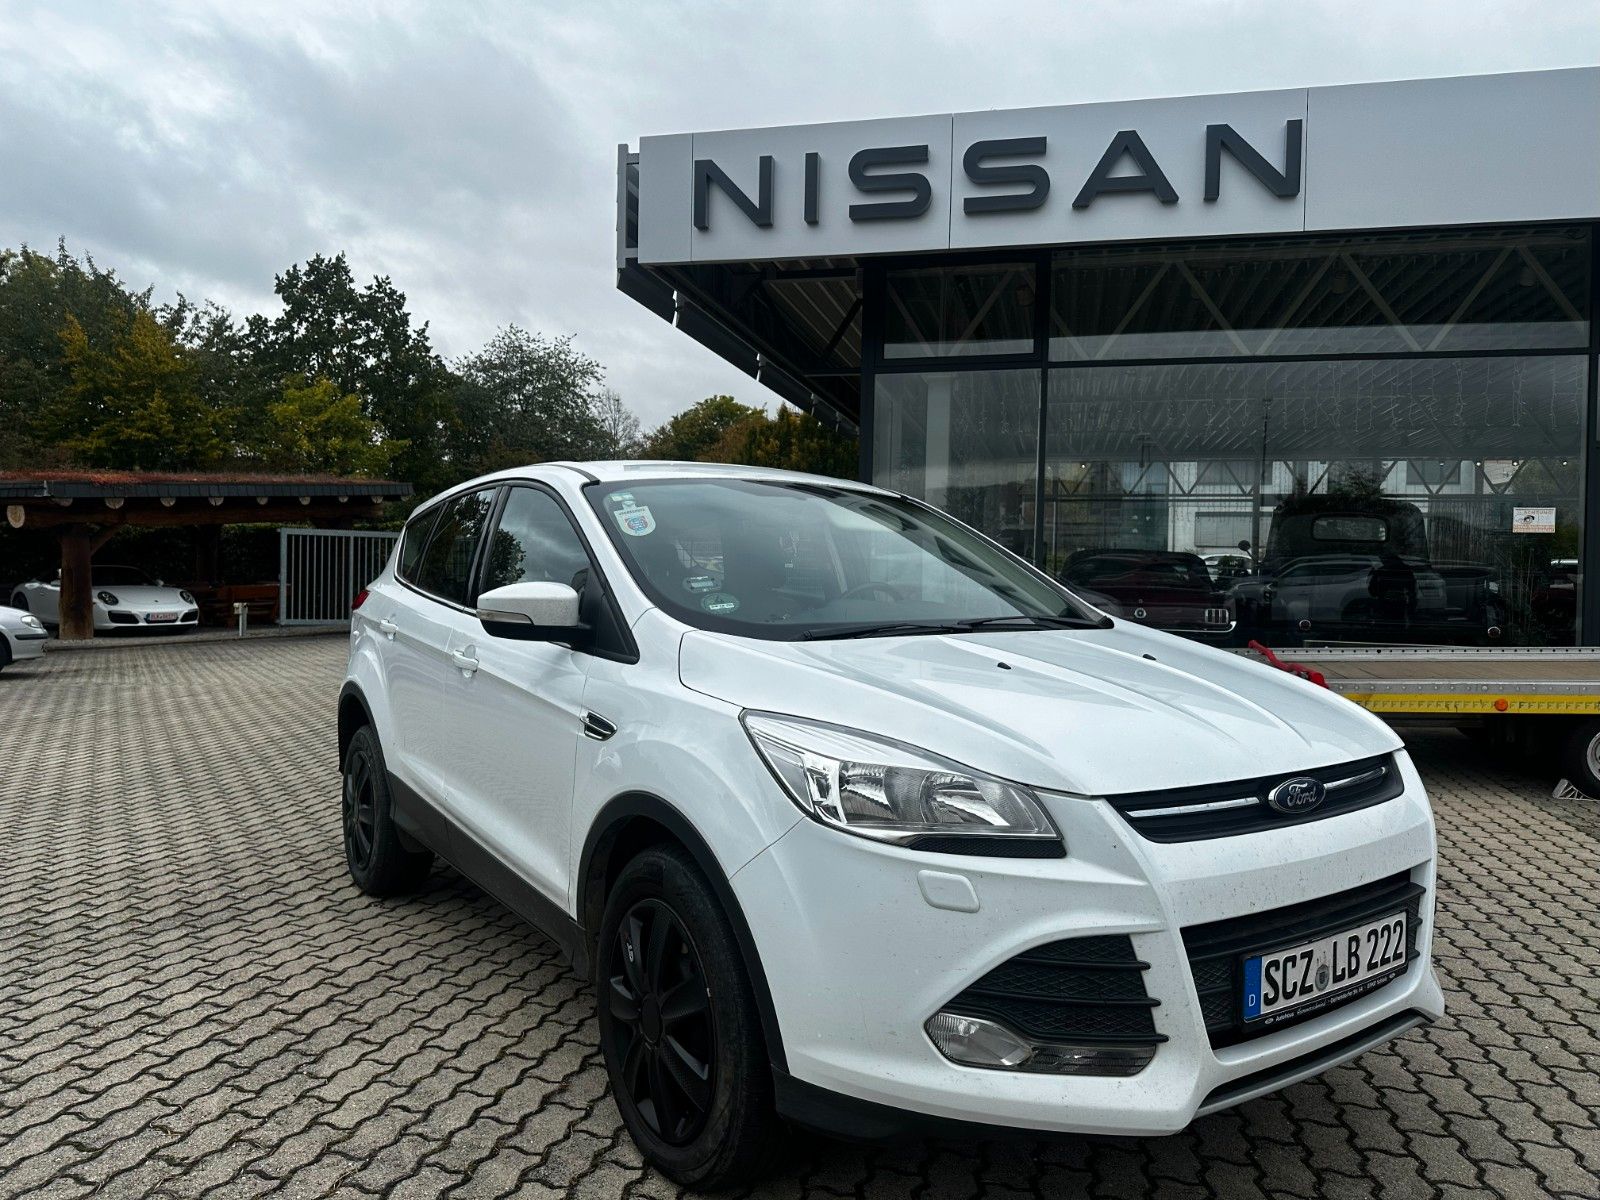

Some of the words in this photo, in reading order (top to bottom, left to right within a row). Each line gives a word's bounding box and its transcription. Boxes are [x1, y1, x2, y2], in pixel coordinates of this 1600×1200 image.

[693, 118, 1303, 231] NISSAN
[1287, 782, 1317, 807] Ford
[1248, 994, 1256, 1007] D
[1263, 949, 1314, 1006] SCZ
[1332, 934, 1361, 984] LB
[1366, 919, 1404, 972] 222
